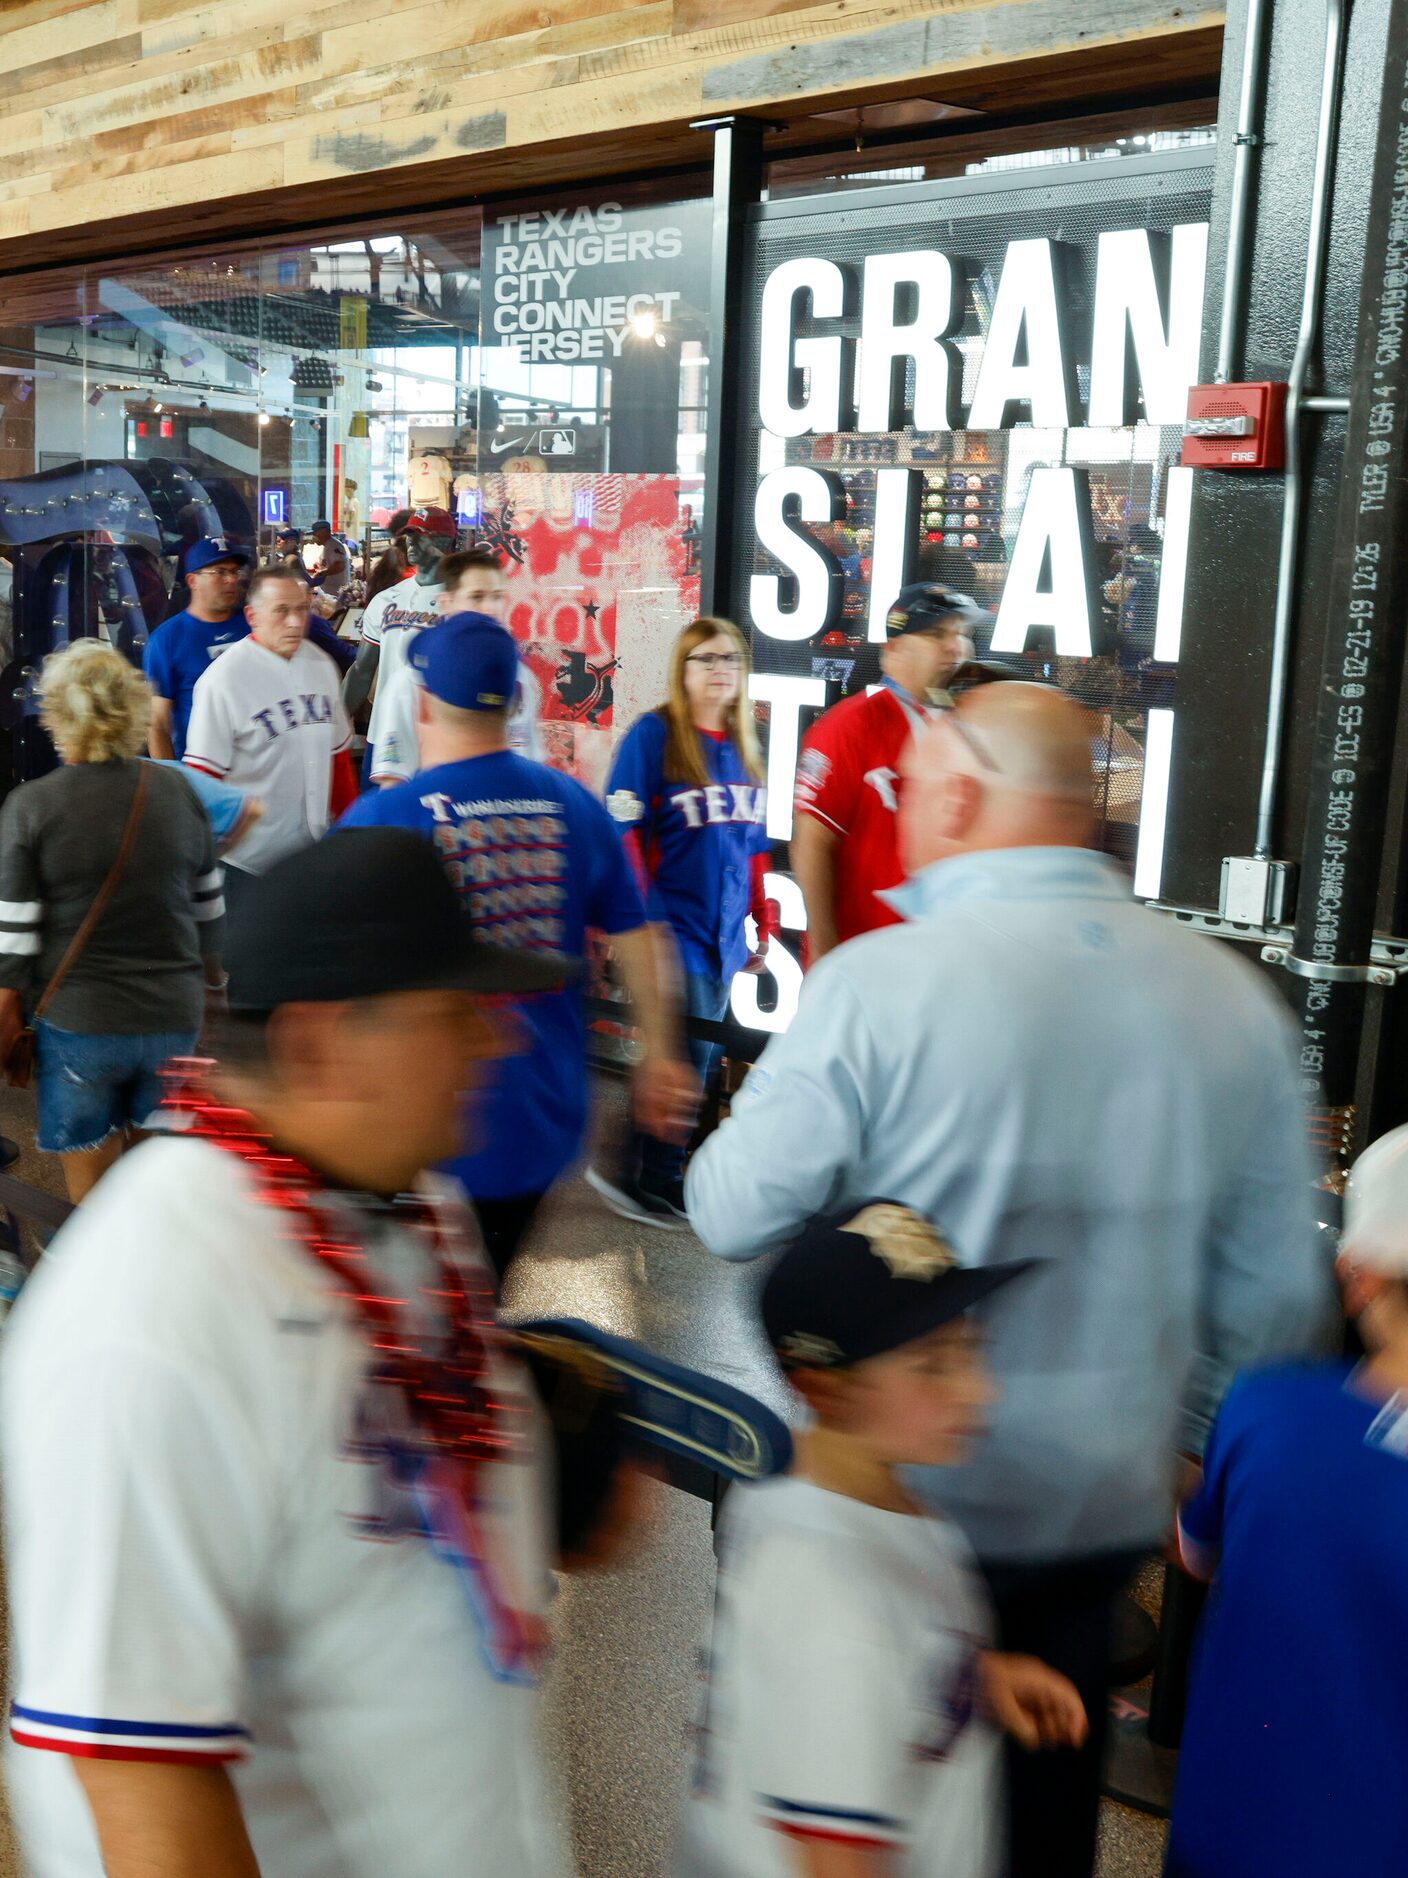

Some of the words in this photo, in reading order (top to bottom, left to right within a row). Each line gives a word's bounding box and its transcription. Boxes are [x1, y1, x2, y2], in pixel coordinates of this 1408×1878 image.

[497, 202, 623, 244] TEXAS
[495, 227, 682, 274] RANGERS
[494, 268, 577, 304] CITY
[493, 291, 680, 334] CONNECT
[1368, 402, 1395, 435] USA
[1231, 452, 1257, 462] FIRE
[1359, 463, 1389, 514] TYLER
[1343, 599, 1375, 678] 02-21-19
[1326, 790, 1353, 831] CODE
